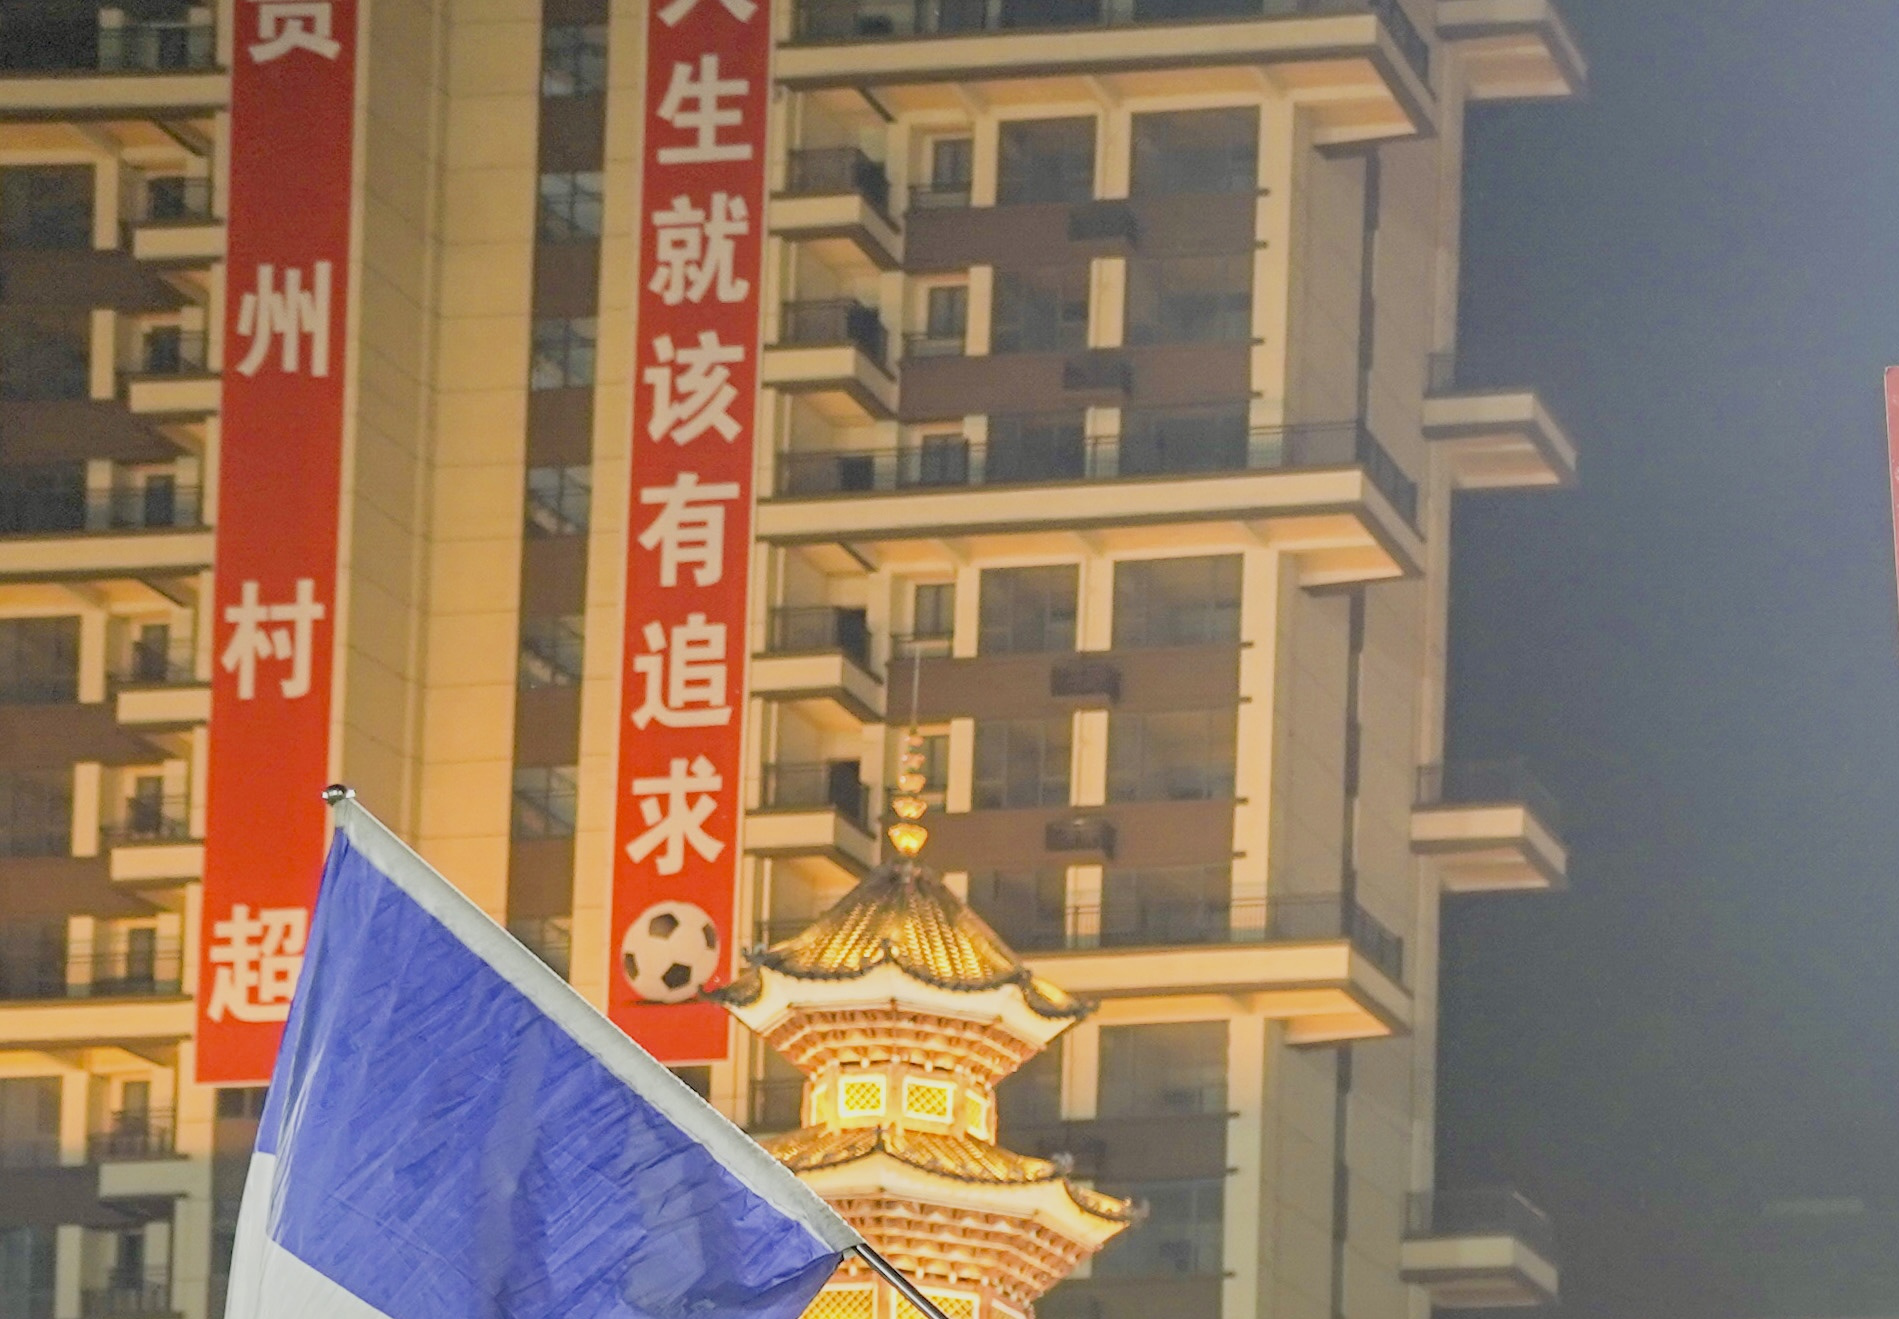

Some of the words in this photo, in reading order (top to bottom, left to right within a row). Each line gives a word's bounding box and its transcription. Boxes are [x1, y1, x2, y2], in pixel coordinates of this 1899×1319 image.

[625, 0, 757, 877] 生就该有追求
